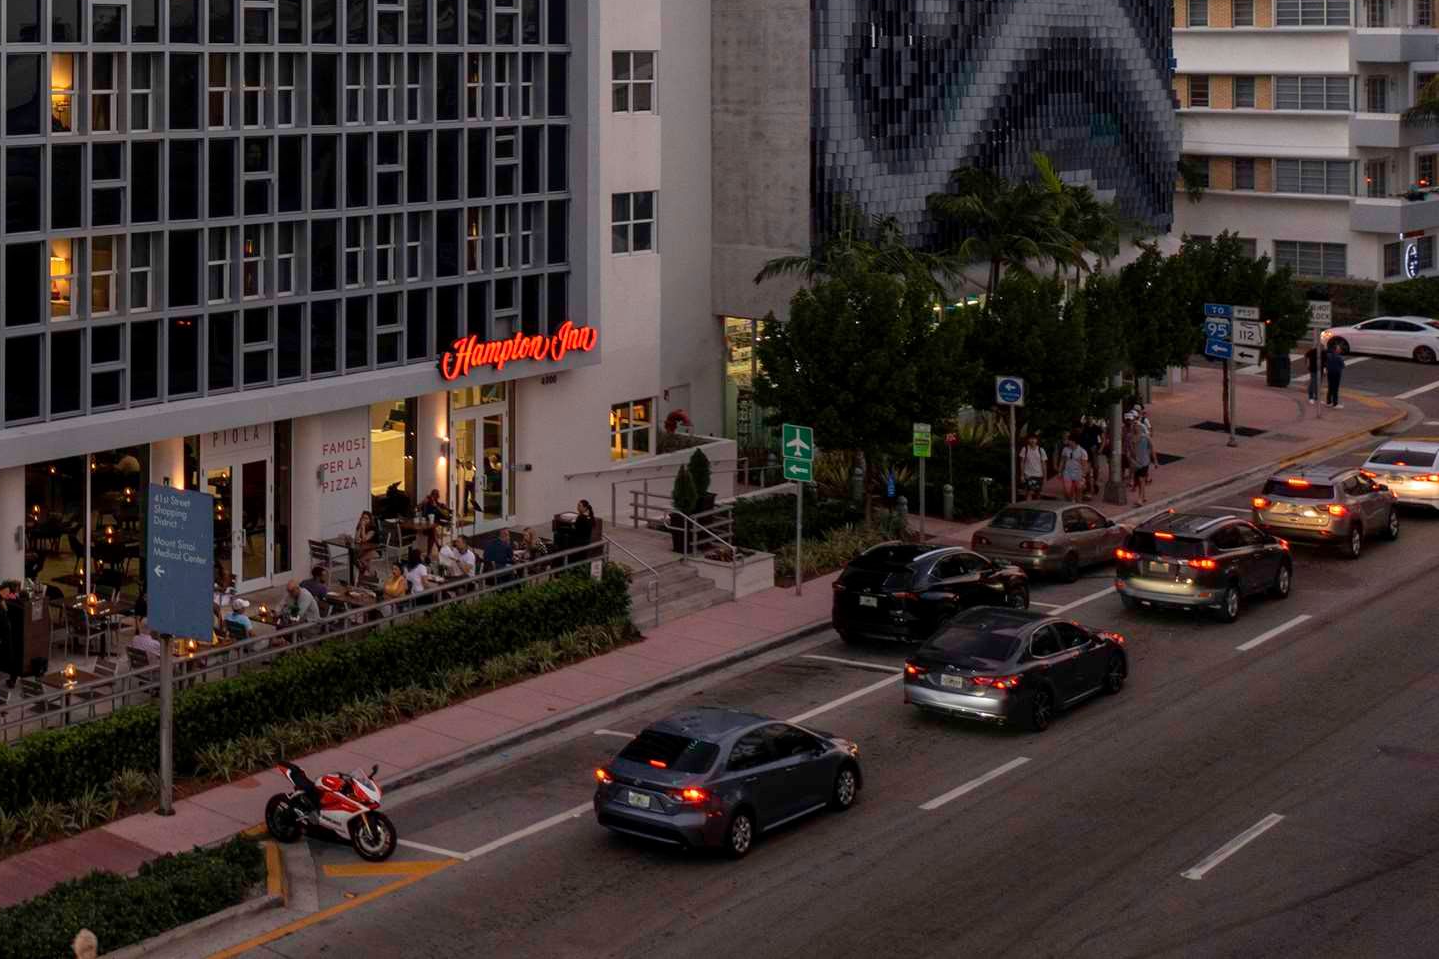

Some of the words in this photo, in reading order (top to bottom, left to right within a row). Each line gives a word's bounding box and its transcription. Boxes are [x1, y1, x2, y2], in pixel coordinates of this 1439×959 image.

[1211, 306, 1225, 314] TO
[1207, 322, 1228, 338] 95
[1239, 330, 1255, 341] 112
[441, 331, 550, 381] Hampton
[551, 320, 598, 362] Inn
[212, 425, 260, 449] PIOLA
[322, 437, 367, 456] FAMOSI
[321, 462, 344, 475] PER
[348, 459, 363, 470] LA
[321, 476, 358, 494] PIZZA
[170, 496, 191, 508] Street
[153, 504, 188, 522] Shopping
[153, 515, 178, 528] District
[153, 536, 176, 548] Mount
[153, 547, 182, 560] Medical
[182, 552, 208, 565] Center
